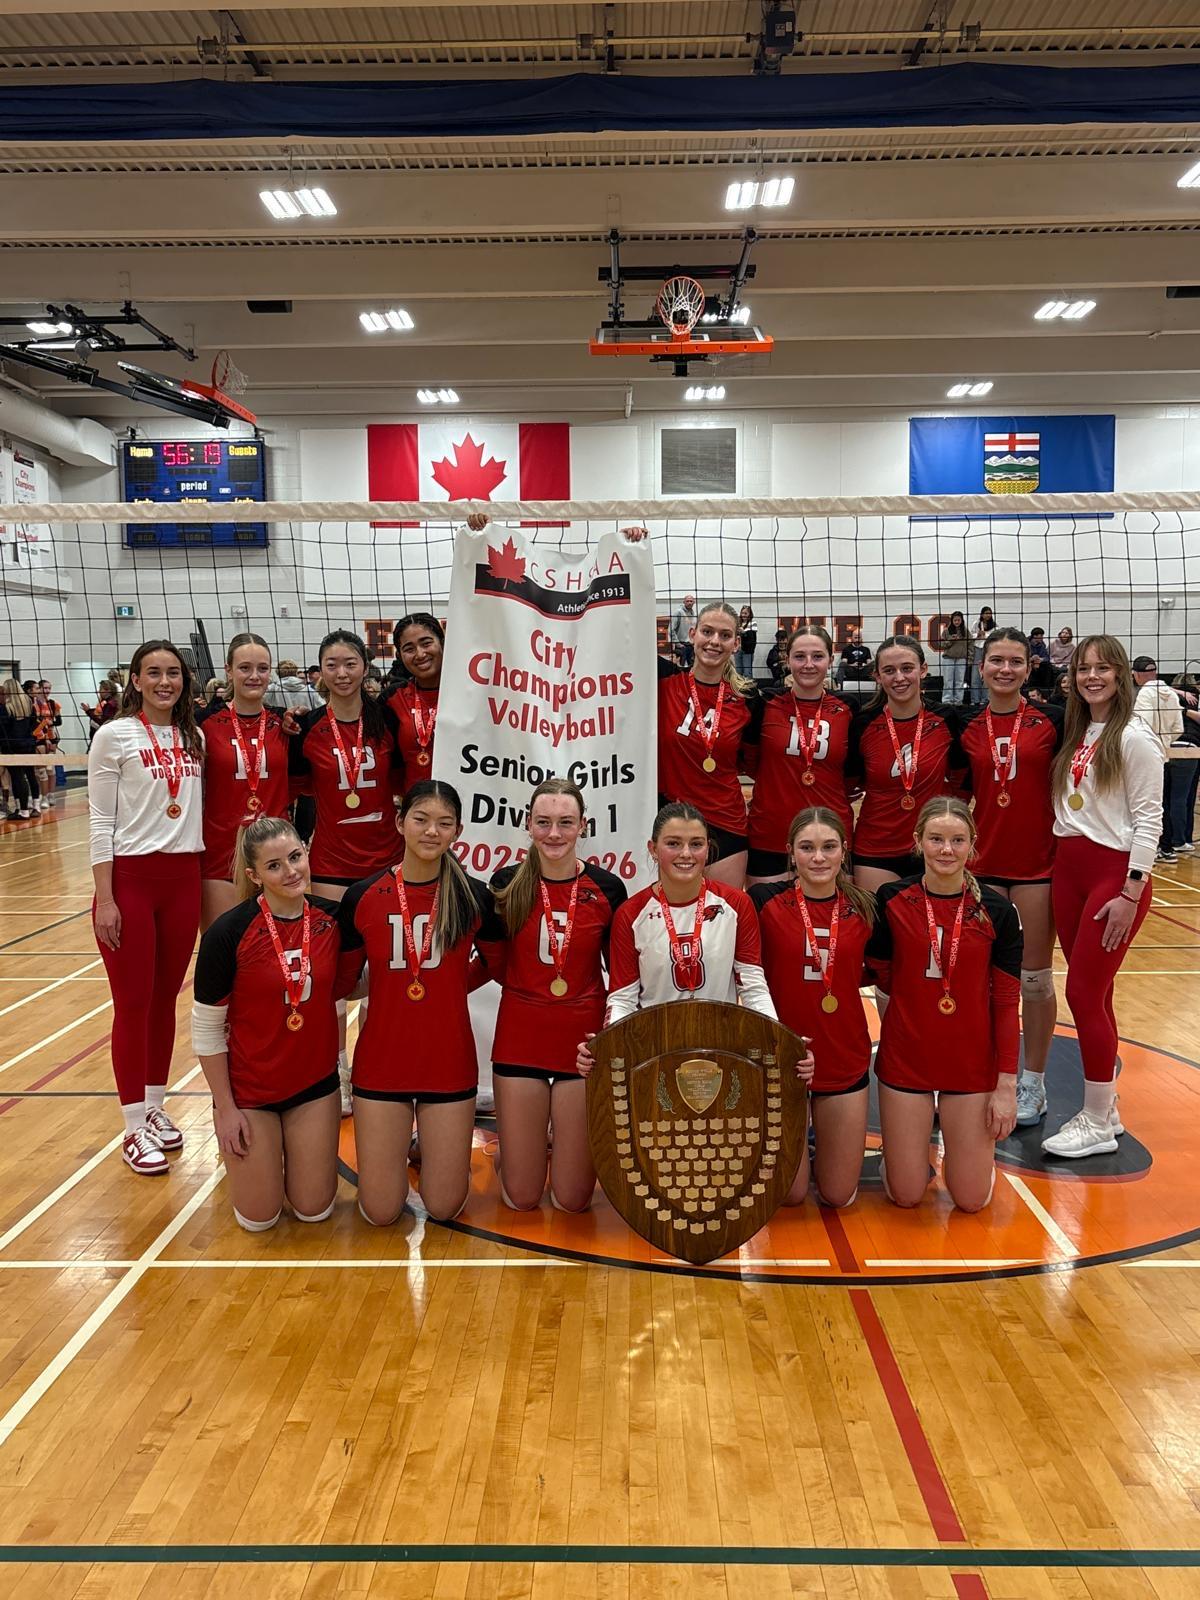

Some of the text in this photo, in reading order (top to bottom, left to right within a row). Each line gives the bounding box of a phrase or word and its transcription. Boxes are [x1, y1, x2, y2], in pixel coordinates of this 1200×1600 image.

[130, 446, 153, 457] Home
[229, 445, 257, 456] Guests
[181, 480, 207, 491] period
[530, 551, 625, 591] CSHA
[601, 587, 625, 598] 1913
[530, 629, 578, 676] City
[468, 651, 634, 713] Champions
[487, 697, 616, 748] Volleyball
[676, 696, 720, 738] 14
[785, 715, 830, 760] 13
[230, 738, 269, 780] 11
[332, 745, 377, 790] 12
[460, 744, 636, 791] Senior Girls
[994, 736, 1017, 781] 9
[471, 793, 618, 839] Divin 1
[397, 882, 408, 912] CSHSAA
[800, 900, 812, 928] CSHSAA
[265, 912, 279, 941] CSHSAA
[303, 915, 311, 943] CSHSAA
[562, 919, 573, 948] CSHSAA
[661, 902, 673, 931] CSHSAA
[388, 914, 441, 969] 10
[404, 924, 415, 954] CSHSAA
[422, 924, 433, 953] CSHSAA
[538, 911, 568, 965] 6
[547, 920, 558, 950] CSHSAA
[828, 937, 837, 967] CSHSAA
[925, 926, 943, 979] 1
[949, 937, 960, 967] CSHSAA
[279, 953, 291, 982] CSHSAA
[299, 956, 309, 986] CSHSAA
[669, 932, 706, 992] 8
[803, 927, 830, 981] 5
[283, 948, 312, 1005] 3
